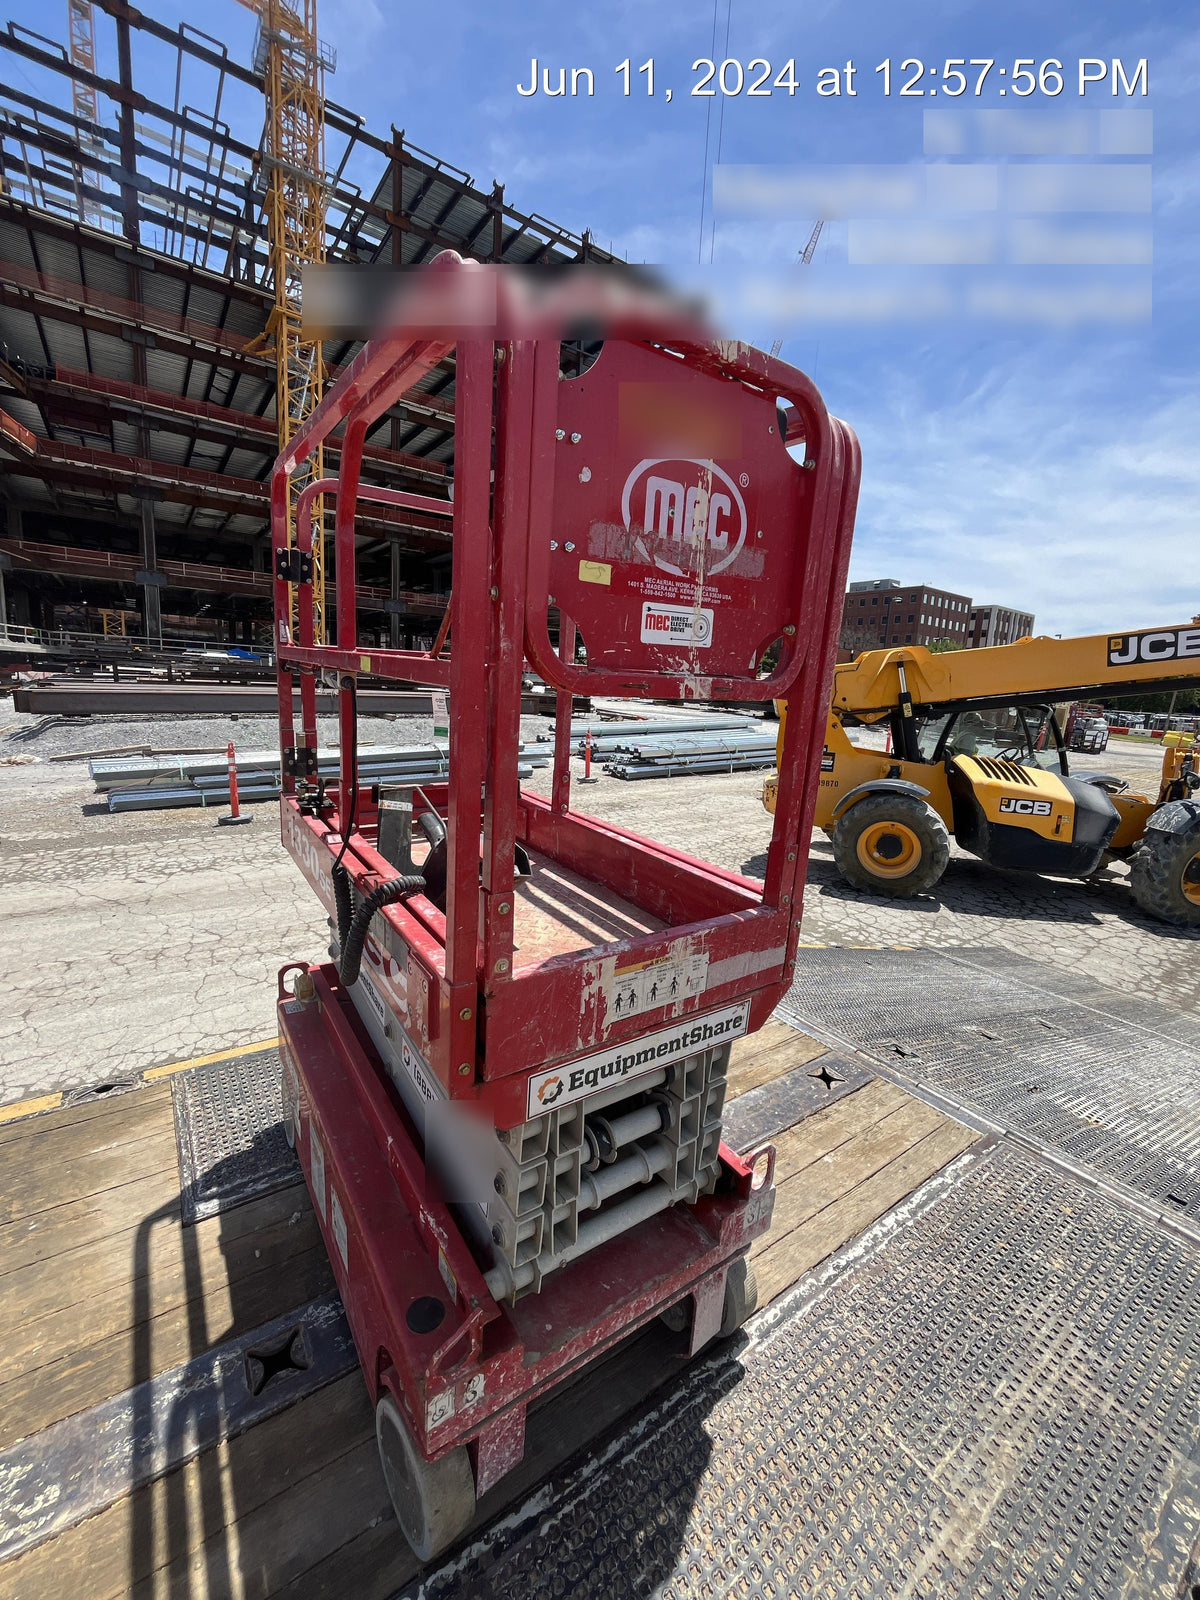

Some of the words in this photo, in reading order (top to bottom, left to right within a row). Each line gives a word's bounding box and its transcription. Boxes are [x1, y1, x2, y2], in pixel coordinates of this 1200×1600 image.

[646, 583, 668, 592] MADERA
[656, 578, 675, 587] AERIAL
[675, 581, 691, 589] WORK
[691, 584, 718, 593] PFORMS
[670, 615, 689, 623] DIRECT
[670, 621, 693, 629] ELECTRIC
[1000, 799, 1051, 816] JCB
[568, 1013, 743, 1093] EquipmentShare
